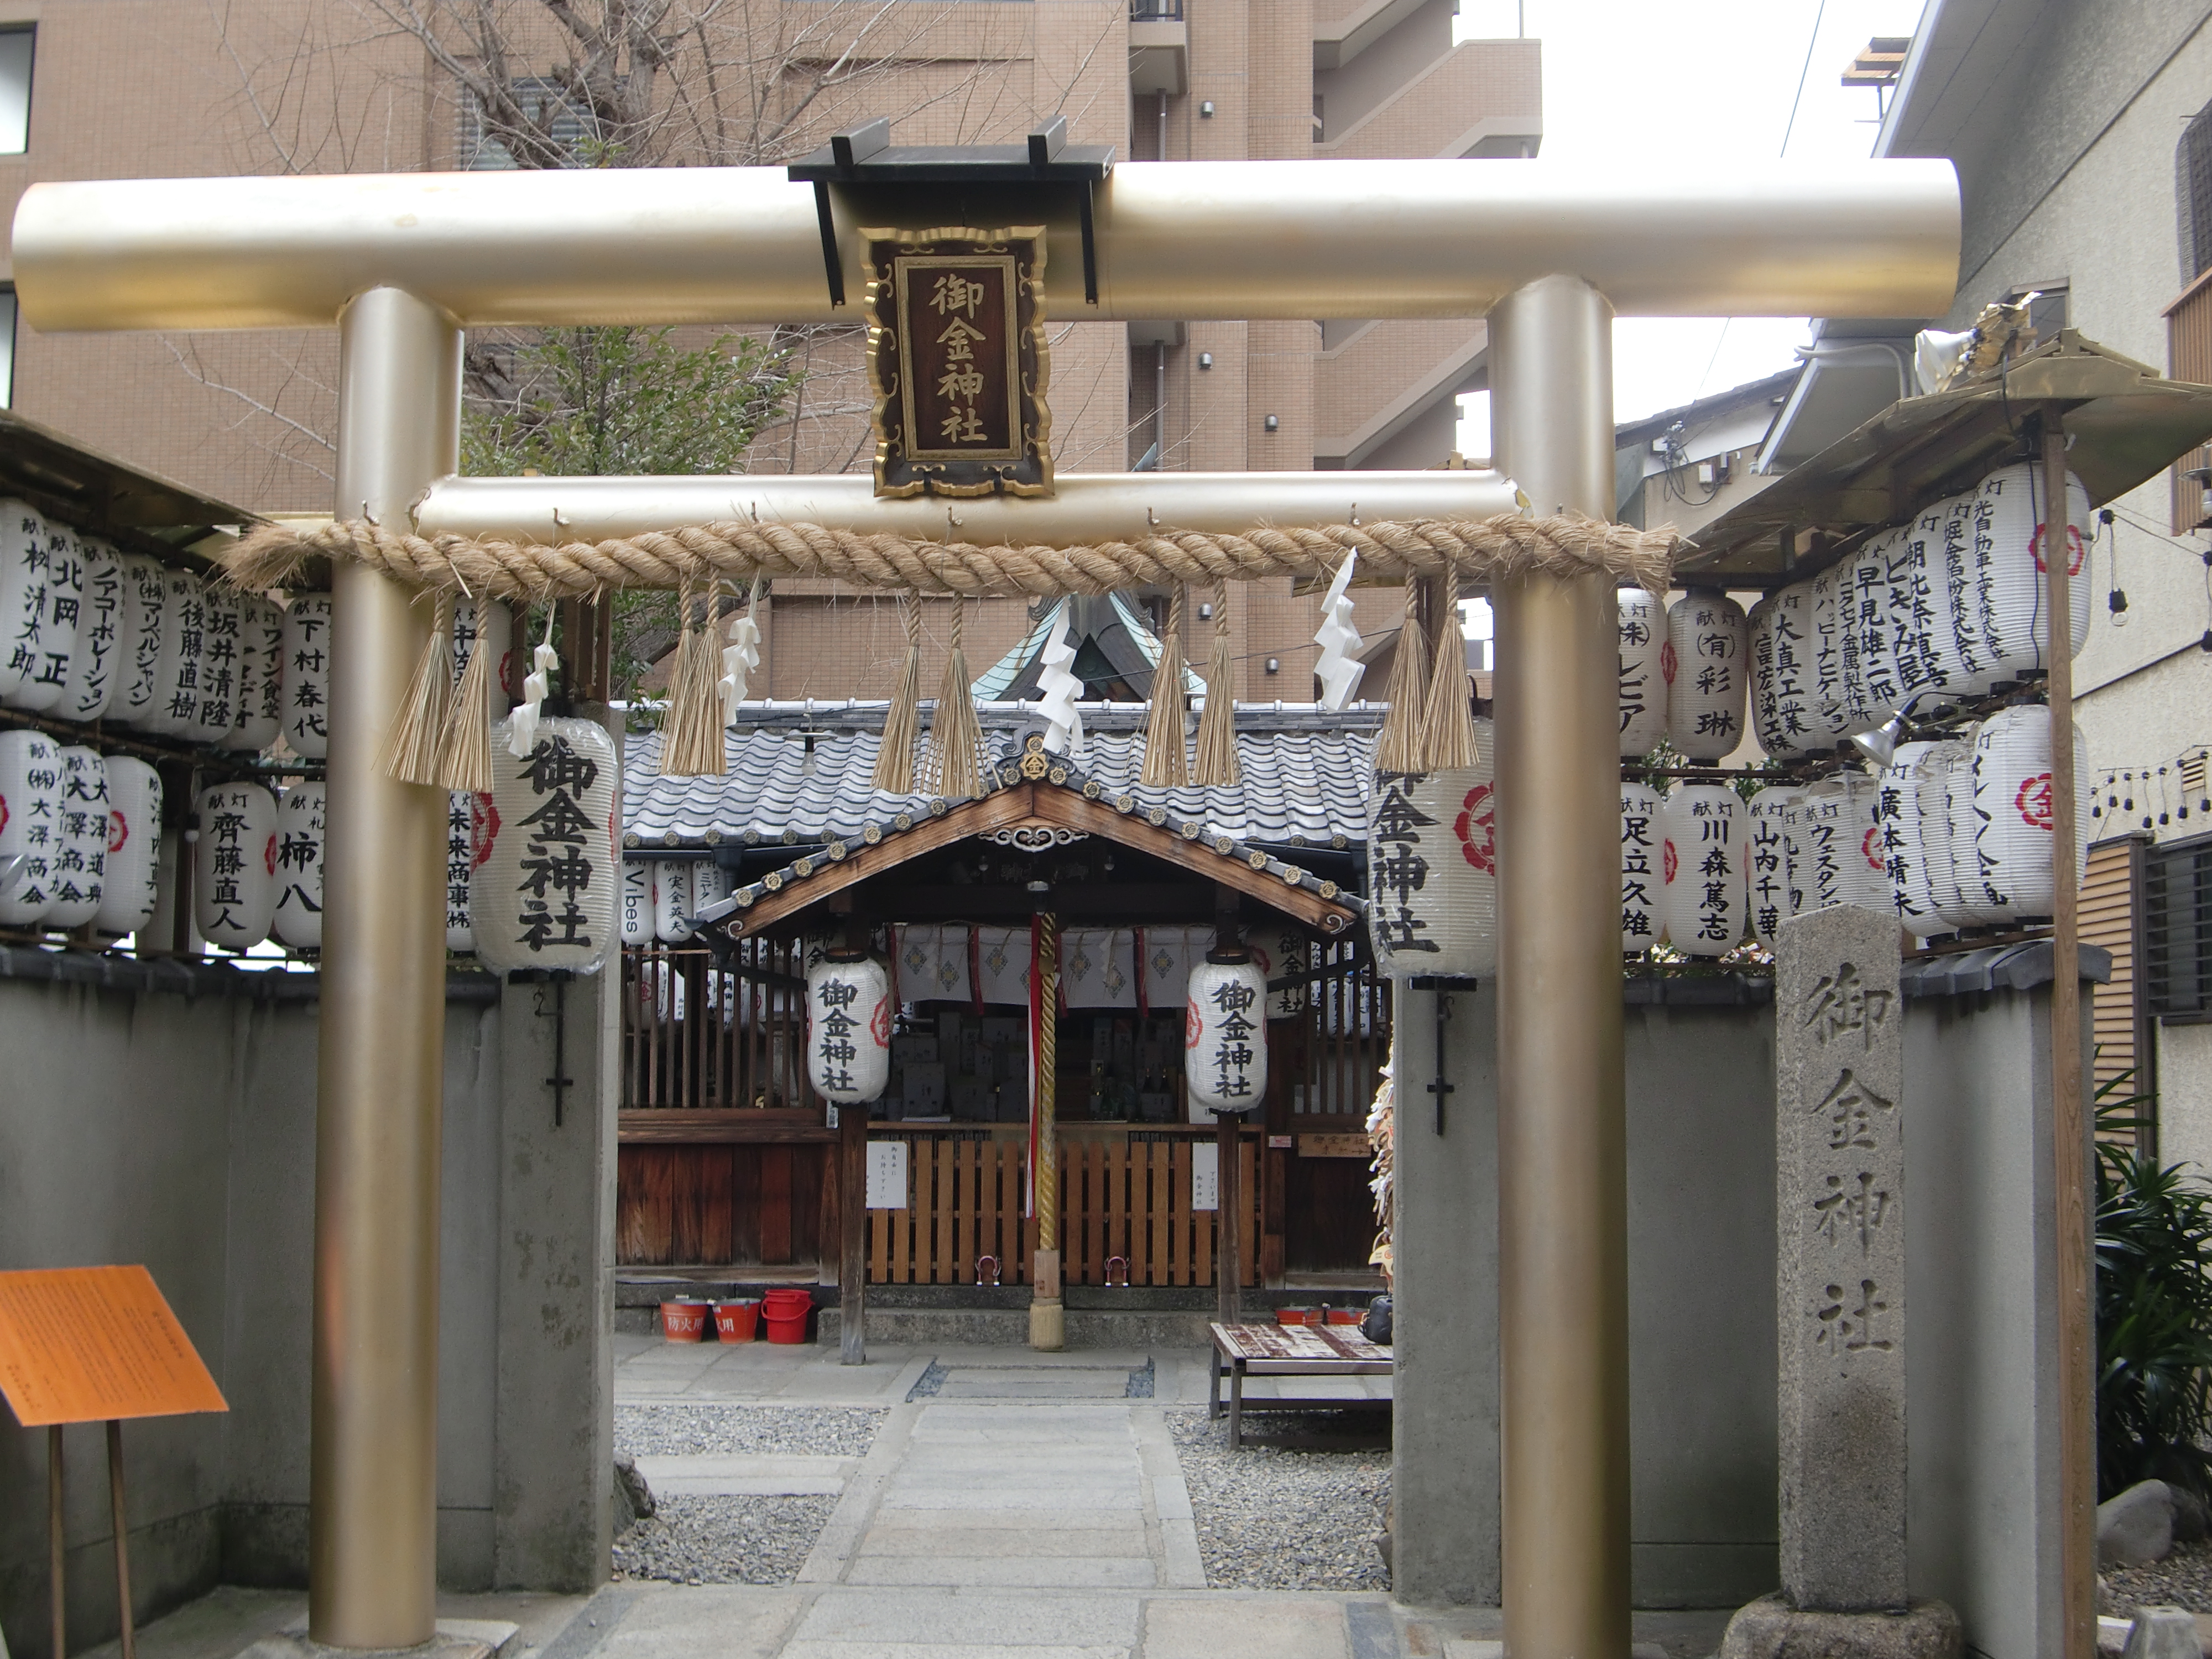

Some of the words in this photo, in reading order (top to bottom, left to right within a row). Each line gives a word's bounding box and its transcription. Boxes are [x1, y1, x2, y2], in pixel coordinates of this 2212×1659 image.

[929, 273, 988, 443] 御金神社
[33, 558, 82, 688] 北岡正
[77, 566, 118, 712] ノアコーポレーション
[165, 599, 205, 720] 後藤直樹
[293, 619, 328, 738] 下村春代
[1697, 611, 1736, 627] 献灯
[1775, 613, 1812, 736] 大真工業
[1855, 566, 1897, 706] 早見雄二郎
[1694, 634, 1736, 737] (有)彩琳
[208, 792, 249, 809] 献灯
[516, 734, 599, 951] 御金神社
[1693, 800, 1733, 817] 献灯
[276, 831, 322, 912] 柿八
[625, 869, 644, 932] Vibes
[1621, 817, 1653, 936] 足立久雄
[1698, 820, 1732, 940] 川森篤志
[1753, 820, 1781, 941] 山内千華
[1811, 824, 1842, 908] ウェスタン
[817, 978, 861, 1092] 御金神社
[1212, 979, 1258, 1098] 御金神社
[1804, 962, 1894, 1357] 御金神社
